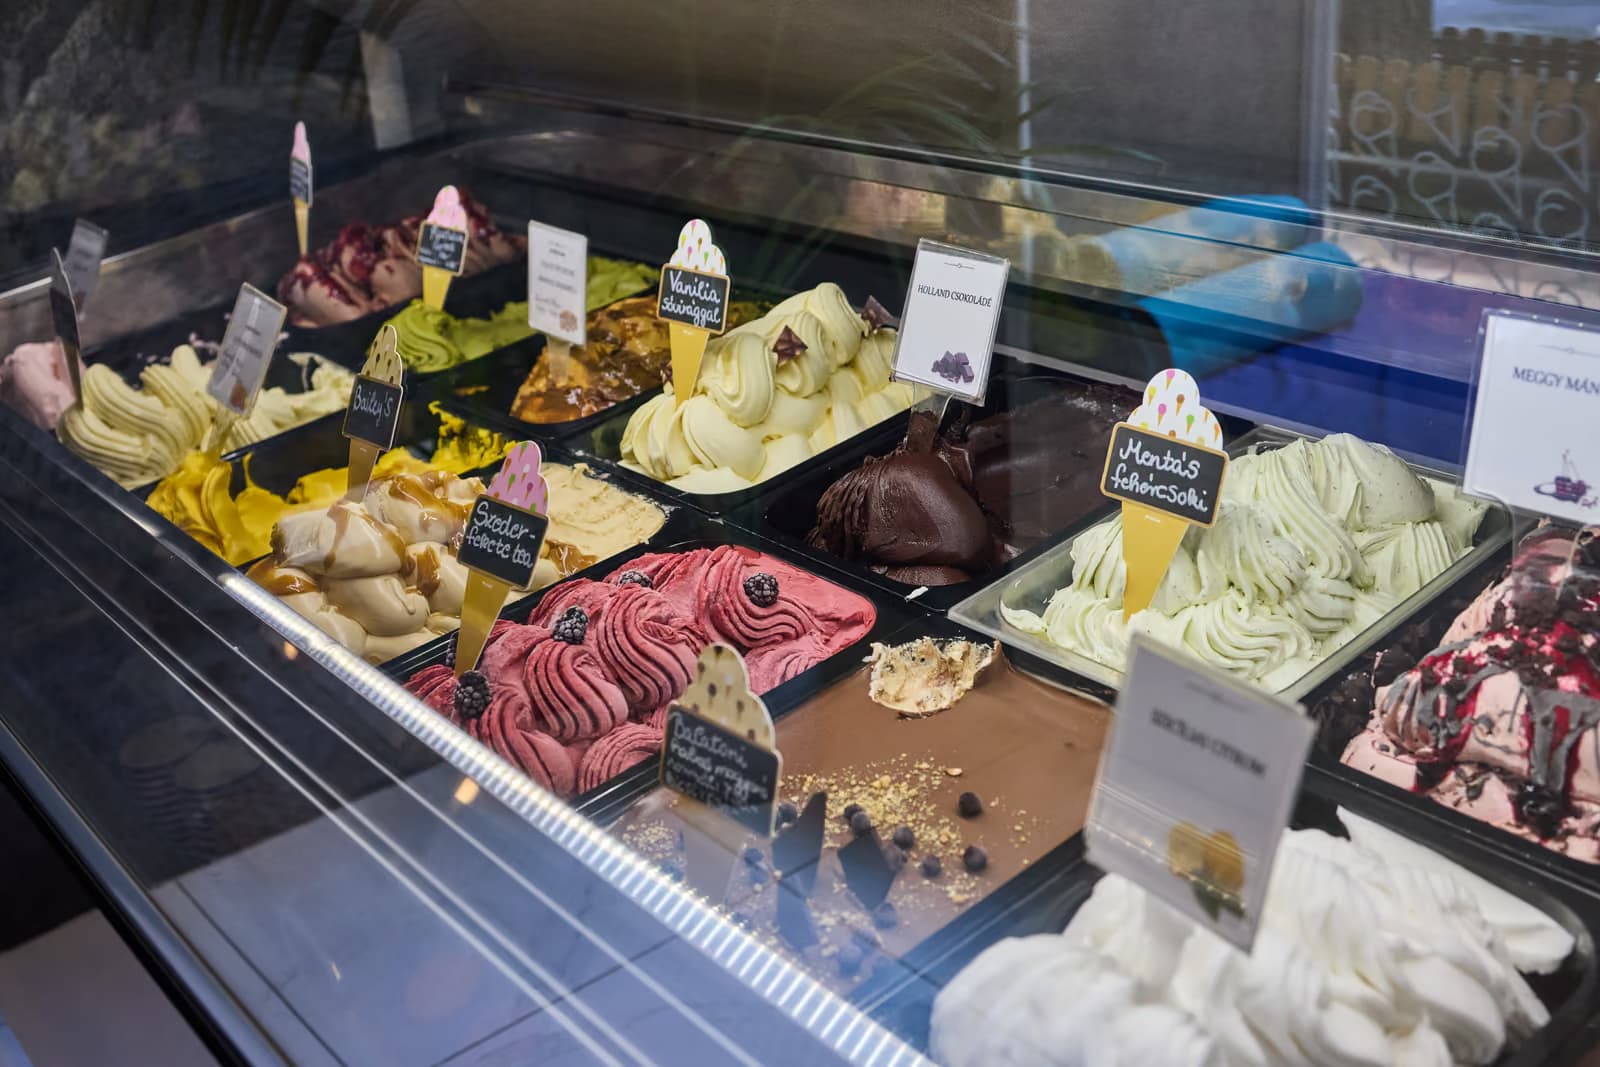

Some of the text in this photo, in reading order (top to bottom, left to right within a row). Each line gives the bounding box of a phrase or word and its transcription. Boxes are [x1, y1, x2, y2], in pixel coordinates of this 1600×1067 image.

[918, 284, 992, 308] HOLLAND CSOKOLÁDÉ
[1511, 366, 1563, 389] MEGGY
[353, 384, 394, 427] Bailey's
[1119, 437, 1201, 480] Mentás
[512, 543, 533, 568] tea
